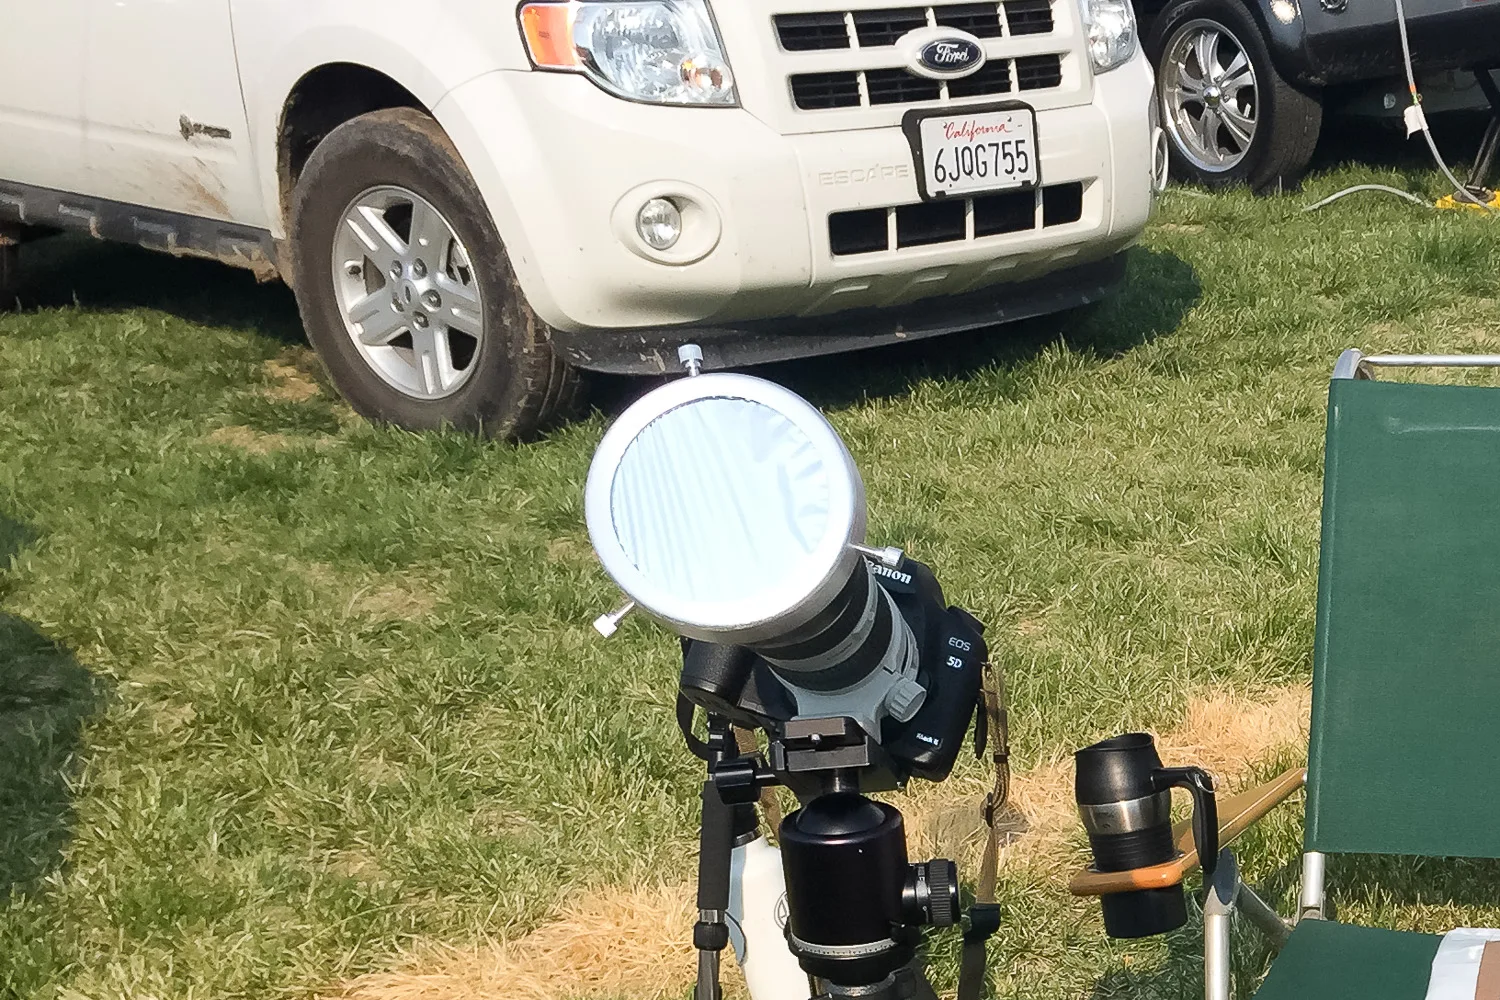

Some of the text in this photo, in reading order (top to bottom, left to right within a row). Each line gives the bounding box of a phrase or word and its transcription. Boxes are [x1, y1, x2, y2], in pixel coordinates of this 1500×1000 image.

[934, 43, 970, 63] Ford
[945, 120, 1012, 142] California
[934, 139, 1029, 183] 6JQG755
[948, 636, 971, 651] EOS
[946, 655, 962, 669] 5D
